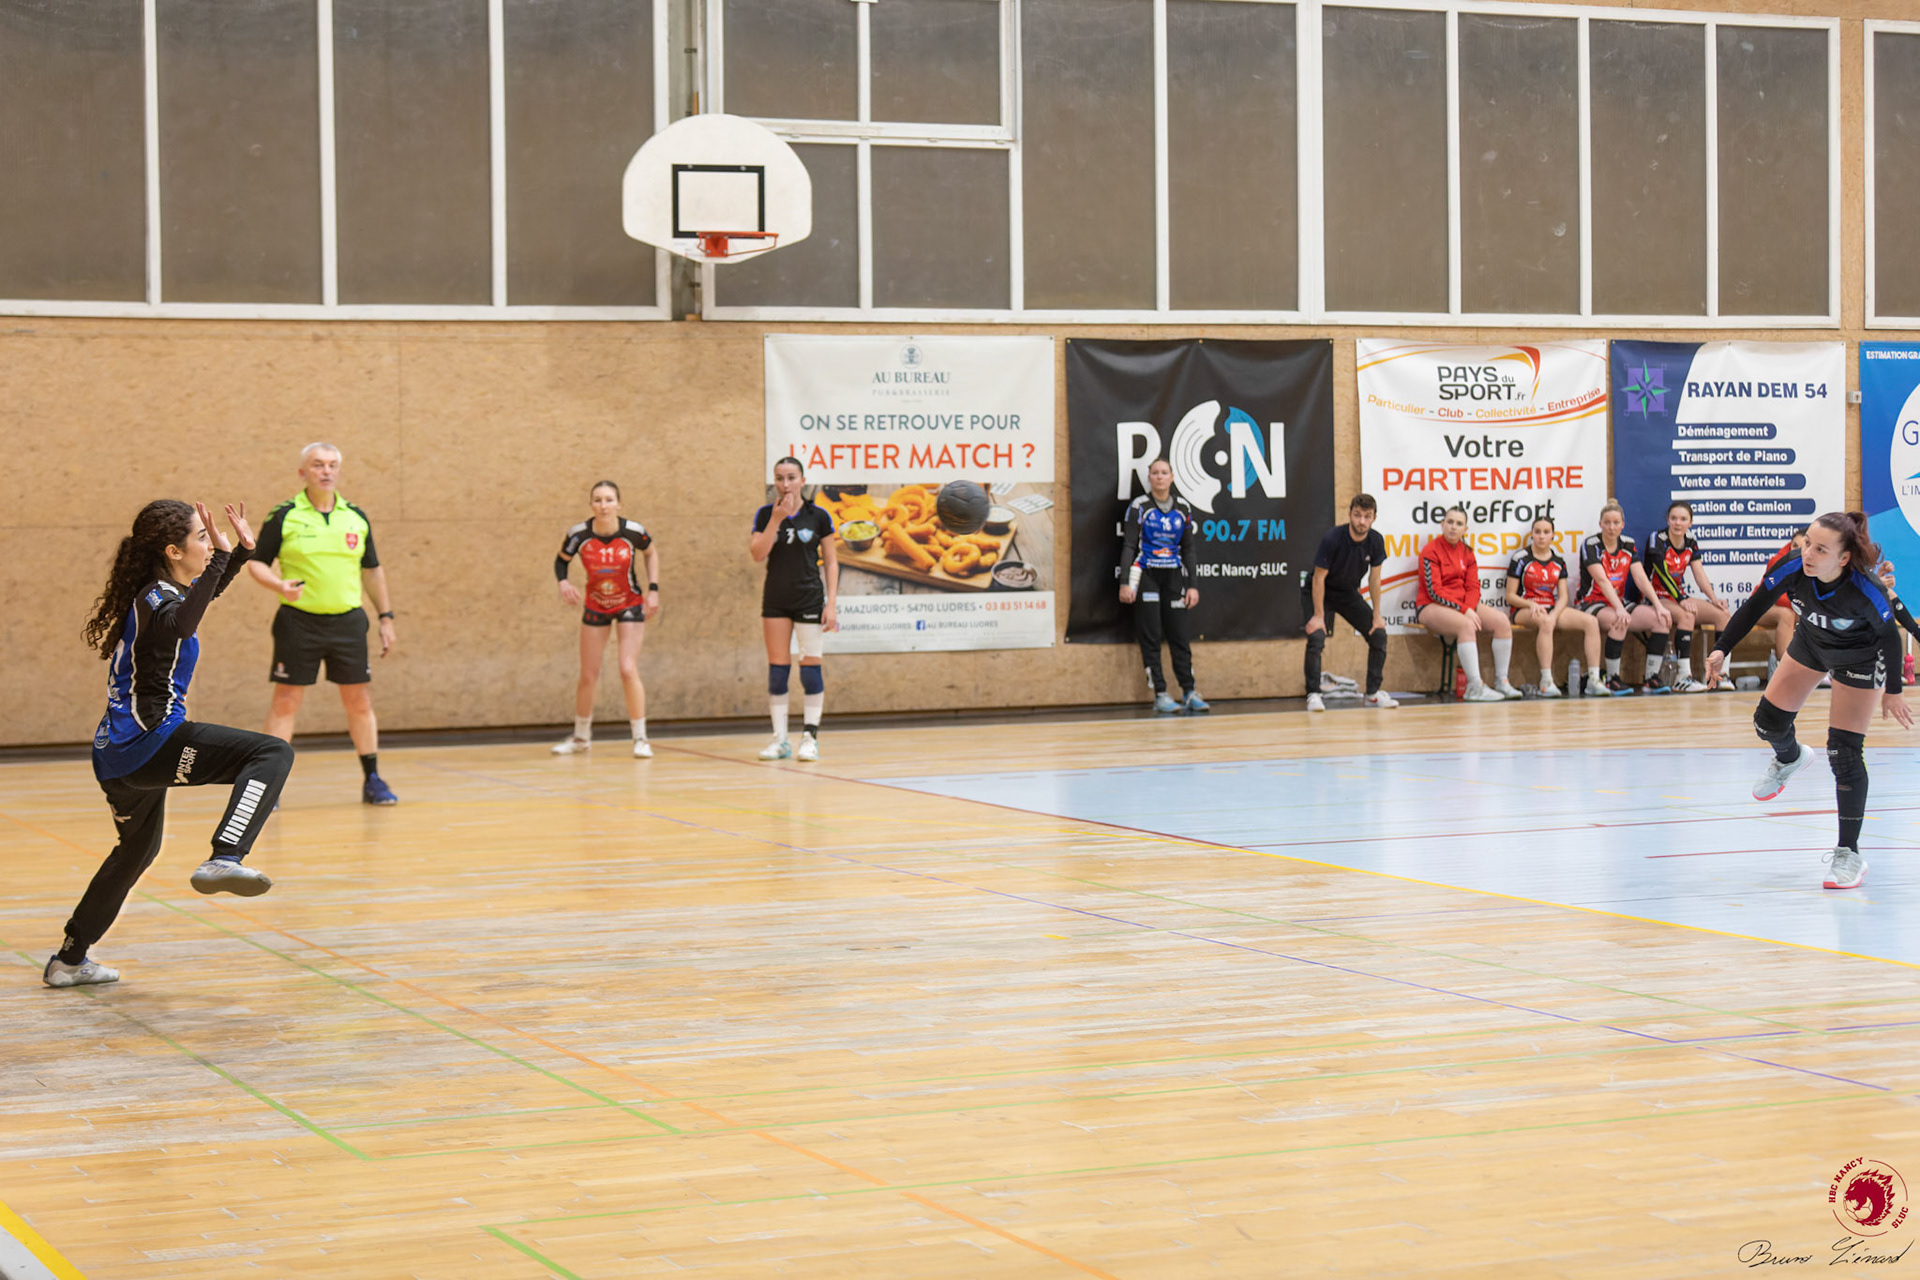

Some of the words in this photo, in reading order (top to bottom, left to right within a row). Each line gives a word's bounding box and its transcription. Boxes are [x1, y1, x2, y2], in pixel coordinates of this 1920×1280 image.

[1866, 350, 1908, 360] ESTIMATION
[872, 372, 890, 384] AU
[894, 372, 952, 384] BUREAU
[1437, 366, 1498, 382] PAYS
[1502, 374, 1515, 383] du
[1687, 382, 1752, 398] RAYAN
[1757, 382, 1798, 398] DEM
[1804, 382, 1828, 398] 54
[1367, 394, 1426, 415] Particulier
[1437, 407, 1464, 418] Club
[1475, 405, 1536, 418] Collectivité
[1547, 388, 1601, 412] Entreprise
[800, 414, 830, 430] ON
[836, 414, 858, 430] SE
[864, 414, 964, 430] RETROUVE
[970, 414, 1021, 430] POUR
[1678, 425, 1769, 438] Déménagement
[1444, 434, 1525, 458] Votre
[908, 443, 1013, 469] MATCH
[1022, 442, 1036, 468] ?
[1678, 451, 1734, 464] Transport
[1736, 451, 1751, 462] de
[1754, 451, 1788, 462] Piano
[1382, 466, 1584, 491] PARTENAIRE
[1678, 476, 1711, 488] Vente
[1714, 476, 1727, 487] de
[1730, 476, 1786, 488] Matériels
[1412, 501, 1447, 524] de
[1690, 501, 1726, 512] cation
[1730, 501, 1744, 512] de
[1747, 500, 1792, 512] Camion
[1202, 519, 1251, 542] 90.7
[1257, 520, 1287, 541] FM
[1690, 526, 1738, 538] rticulier
[1746, 526, 1799, 539] Entrepris
[1384, 530, 1584, 558] MUISPRT
[598, 547, 614, 563] 11
[1700, 551, 1728, 564] tion
[1196, 564, 1220, 576] HBC
[1221, 564, 1258, 578] Nancy
[1260, 562, 1288, 576] SLUC
[1478, 578, 1490, 589] 8
[1718, 582, 1734, 593] 16
[1737, 582, 1752, 592] 68
[844, 604, 899, 614] MAZUROTS
[907, 603, 934, 612] 54710
[936, 602, 976, 612] LUDRES
[984, 601, 998, 611] 03
[1013, 600, 1022, 610] 51
[1024, 600, 1034, 610] 14
[1807, 612, 1828, 629] 41
[176, 746, 191, 774] INTER
[183, 747, 198, 774] SPORT
